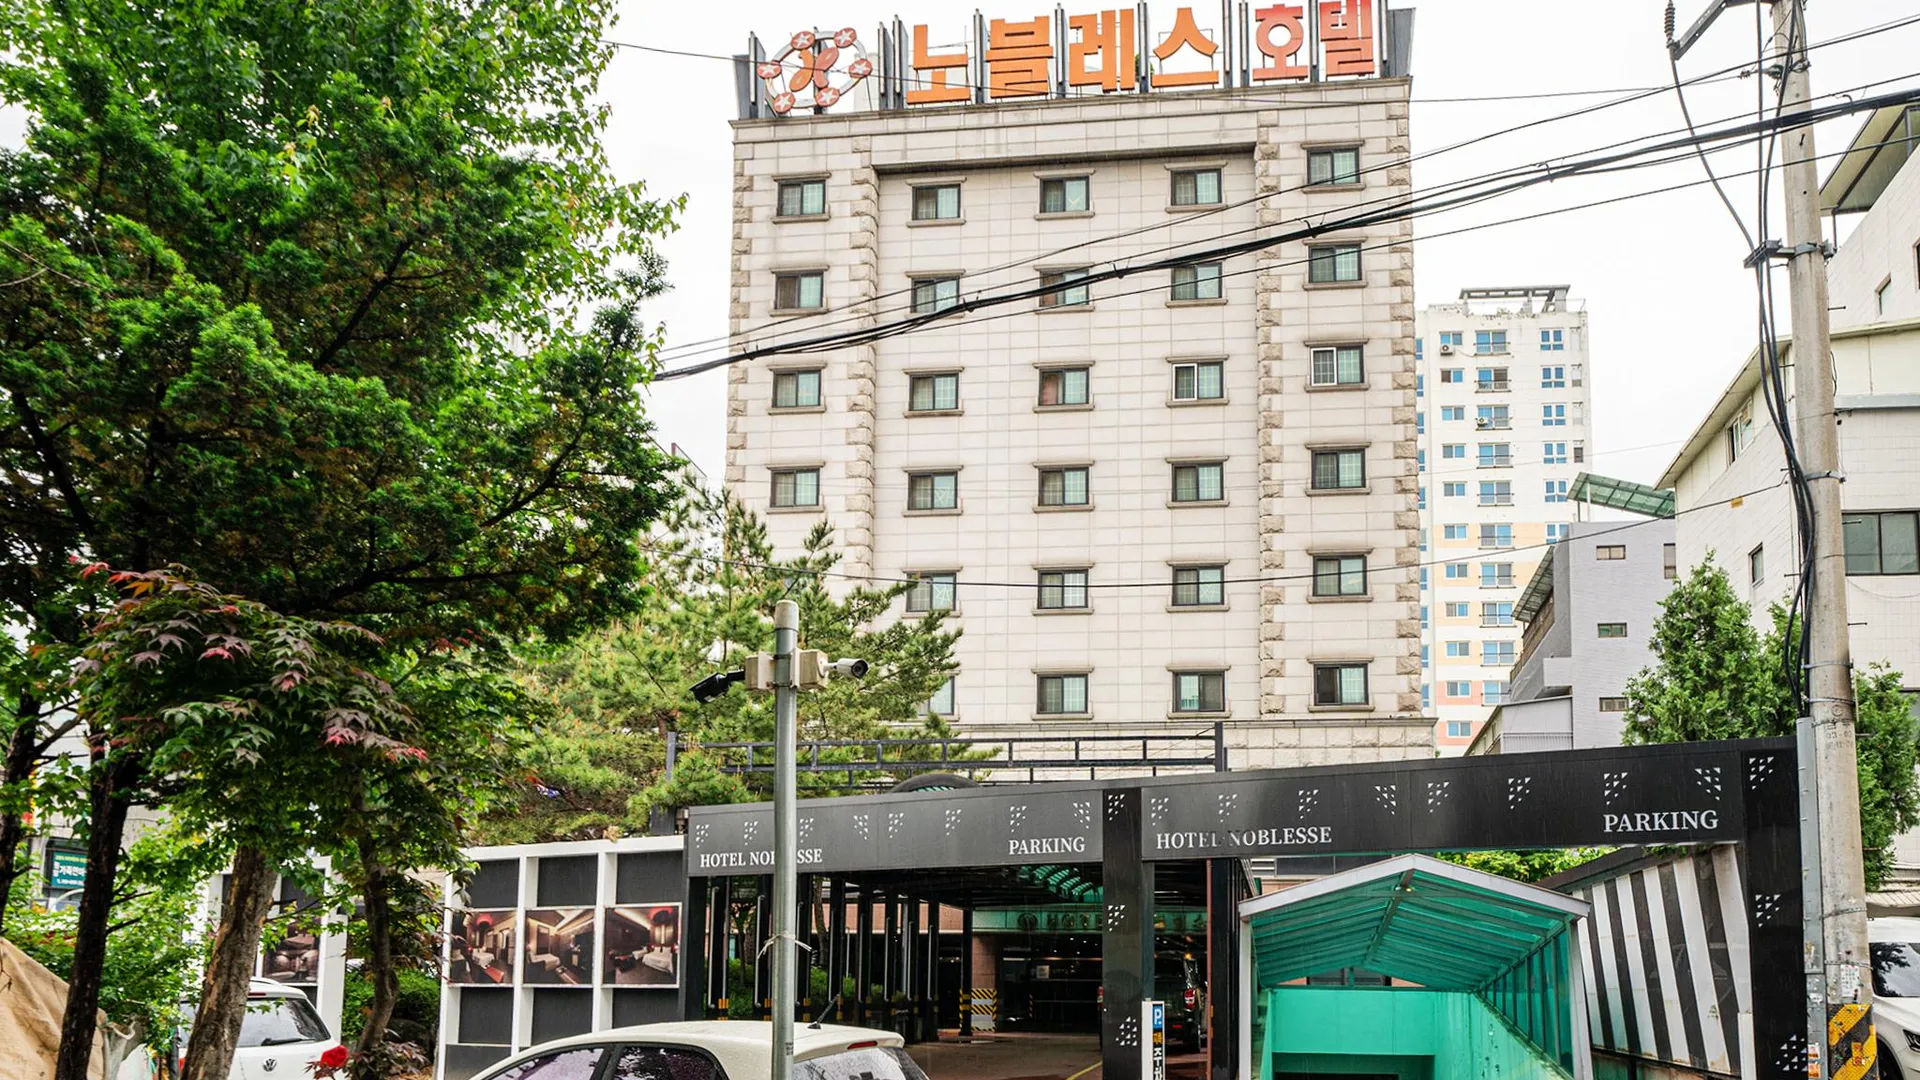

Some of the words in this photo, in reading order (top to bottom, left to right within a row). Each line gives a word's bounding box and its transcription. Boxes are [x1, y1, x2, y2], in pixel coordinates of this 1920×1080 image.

[907, 7, 1219, 104] 노블레스
[1253, 0, 1375, 82] 호텔
[1602, 809, 1719, 833] PARKING
[1008, 836, 1086, 855] PARKING
[1156, 832, 1221, 849] HOTEL
[1227, 826, 1333, 847] NOBLESSE
[700, 852, 746, 868] HOTEL
[749, 848, 823, 866] NOSSE
